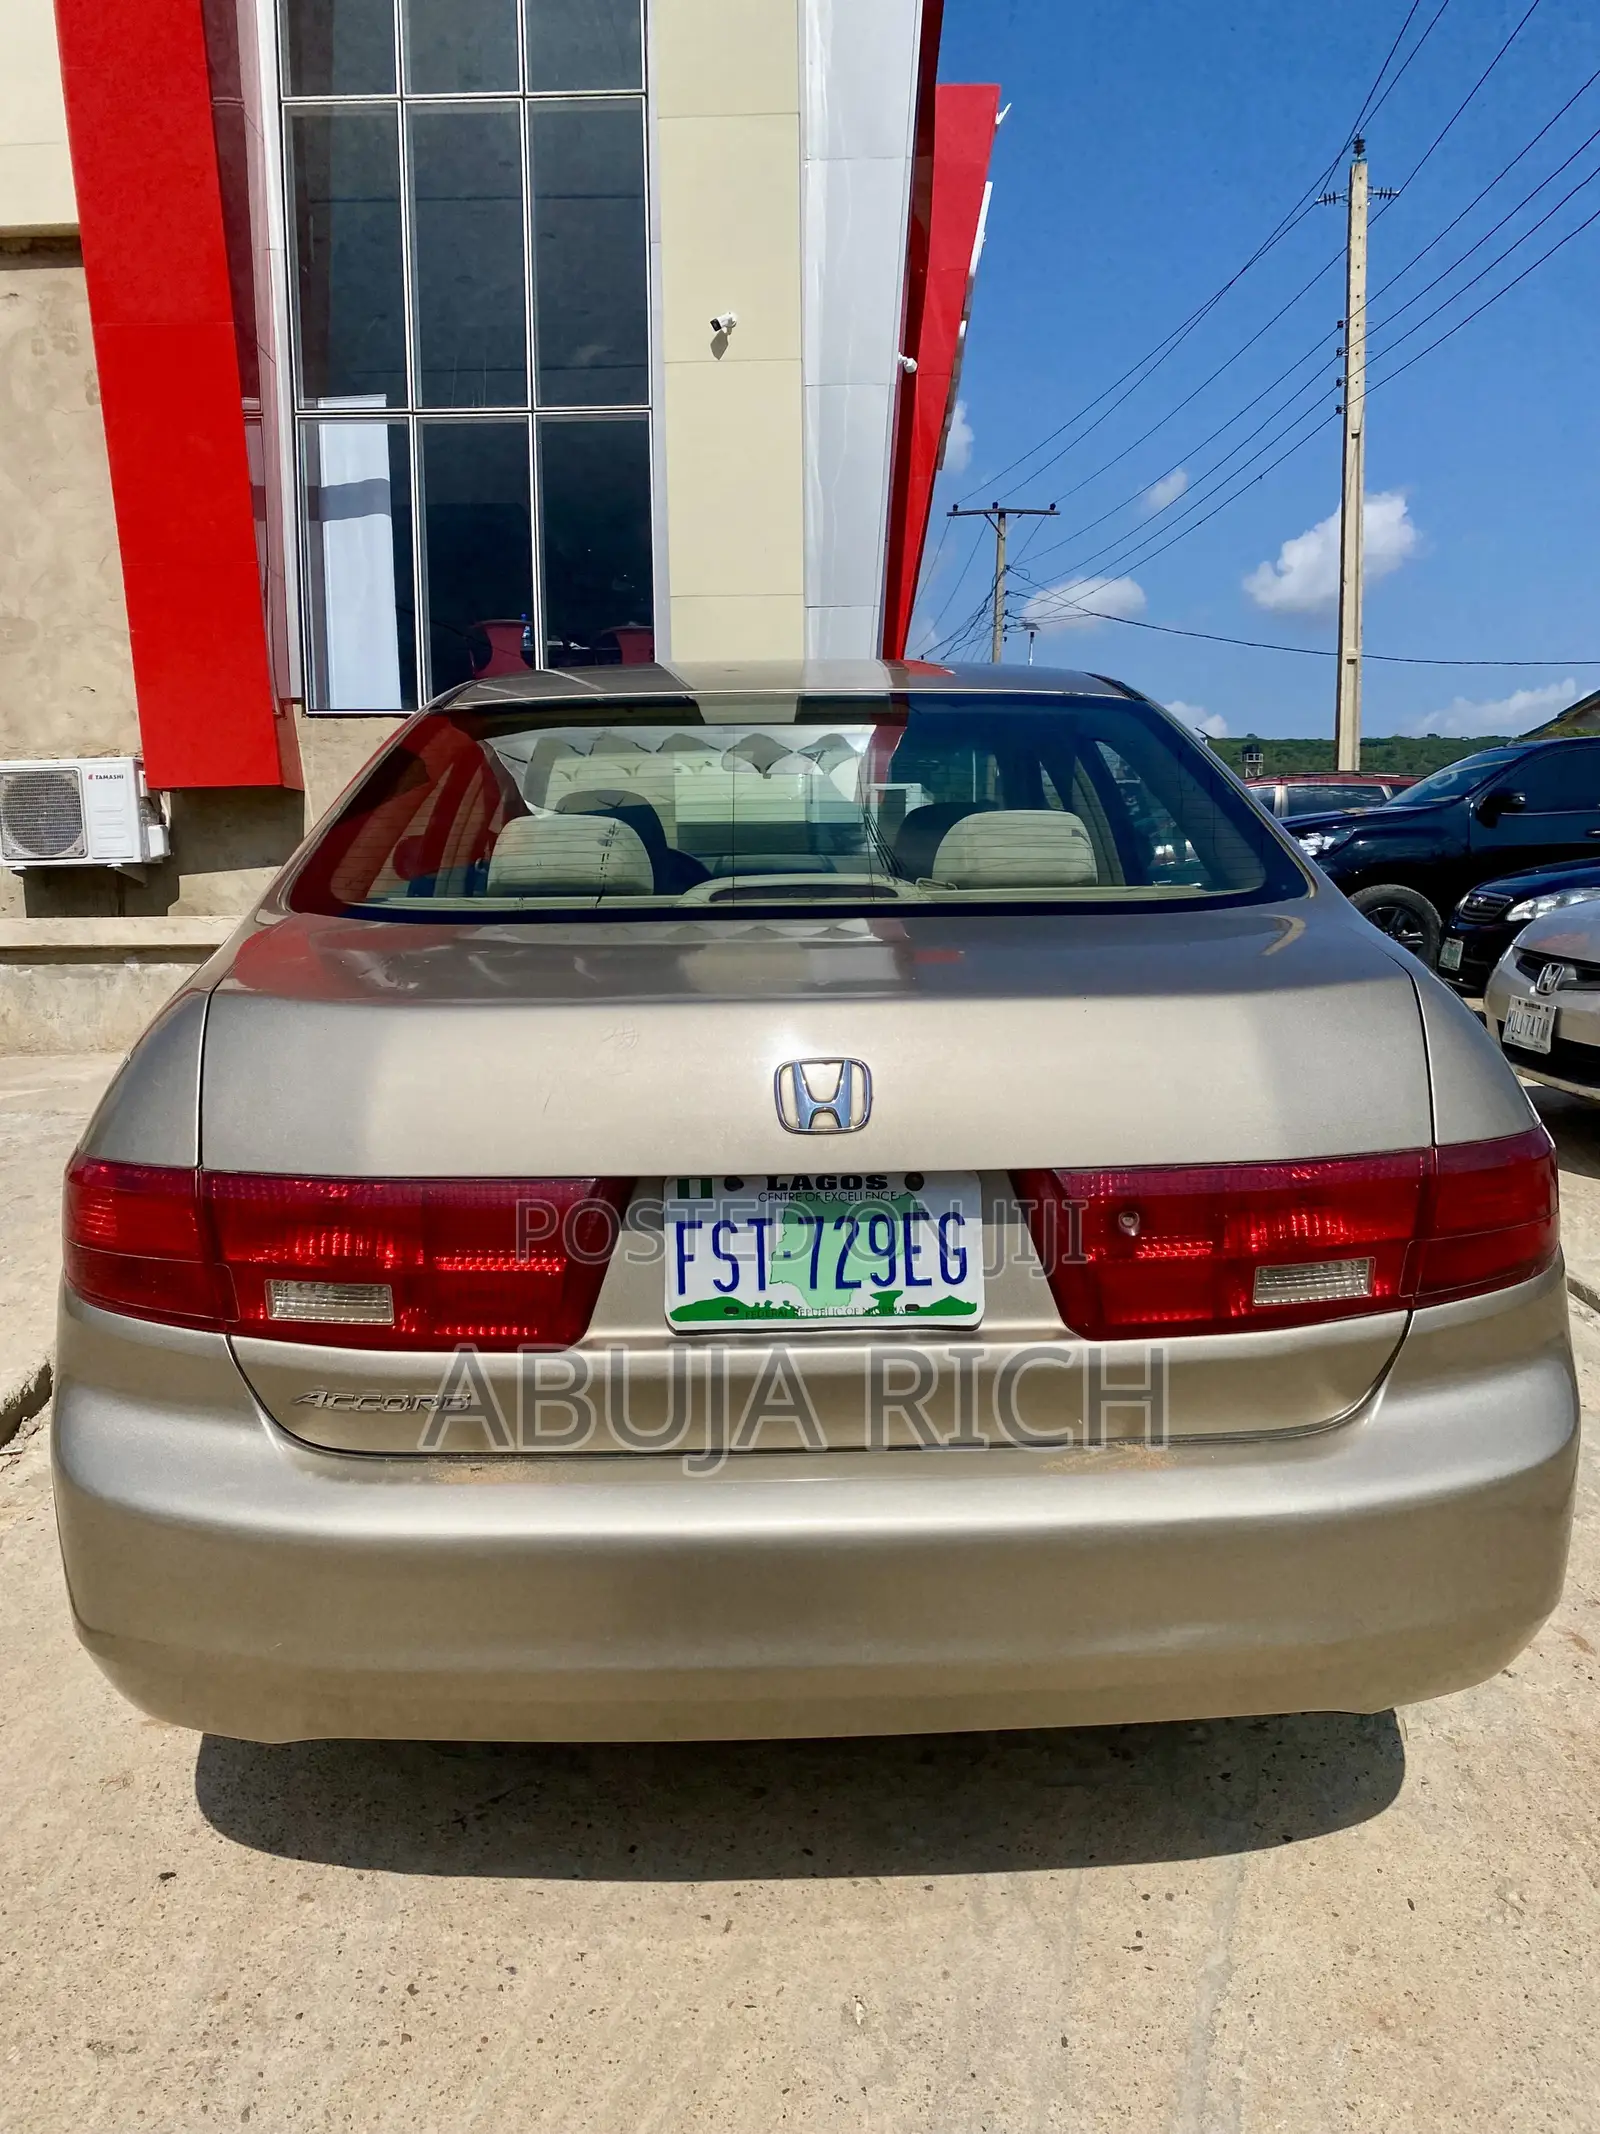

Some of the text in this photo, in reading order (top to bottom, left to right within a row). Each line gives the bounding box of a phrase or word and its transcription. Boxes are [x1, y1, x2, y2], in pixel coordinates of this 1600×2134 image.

[766, 1174, 888, 1191] LAGOS
[758, 1190, 897, 1202] CENTRE OF EXCELLENCE
[675, 1211, 967, 1295] FST-729EG
[845, 1306, 859, 1316] OF
[296, 1390, 472, 1412] ACCORD
